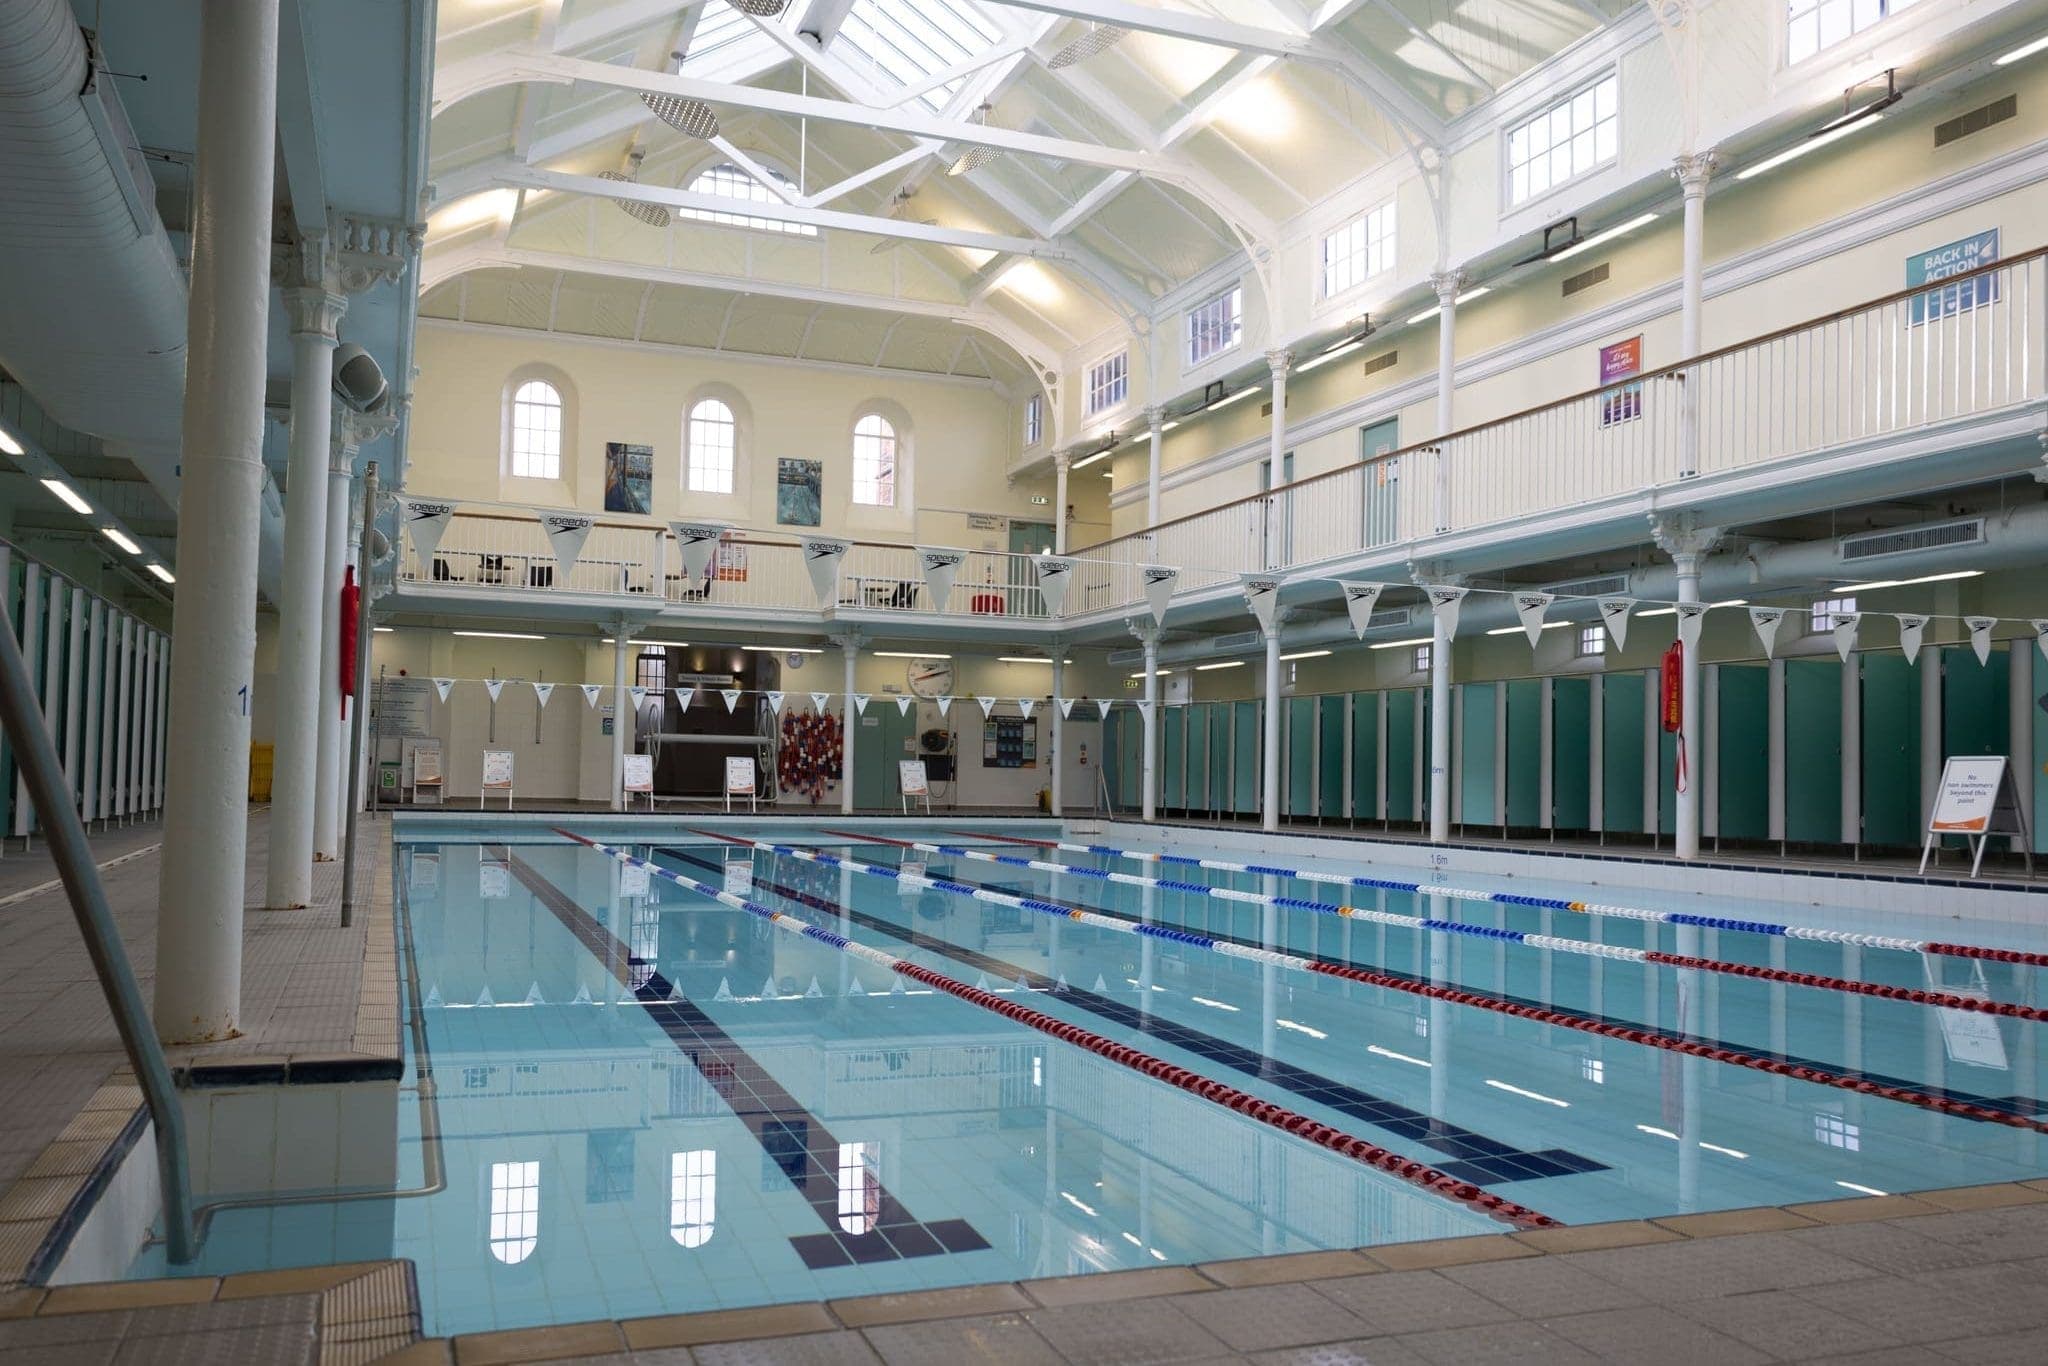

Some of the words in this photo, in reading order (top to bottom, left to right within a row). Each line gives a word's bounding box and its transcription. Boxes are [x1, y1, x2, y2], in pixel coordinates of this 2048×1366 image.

[1924, 248, 1960, 270] BACK
[1964, 241, 1979, 257] IN
[1925, 257, 1978, 284] ACTION
[408, 502, 450, 514] speedo
[548, 516, 588, 528] speedo
[680, 527, 717, 539] speedo
[808, 542, 843, 553] speedo
[926, 554, 959, 564] speedo
[1039, 561, 1070, 571] speedo
[1145, 568, 1176, 577] speedo
[1248, 581, 1277, 589] speedo
[1347, 586, 1376, 595] speedo
[1950, 789, 1974, 797] beyond
